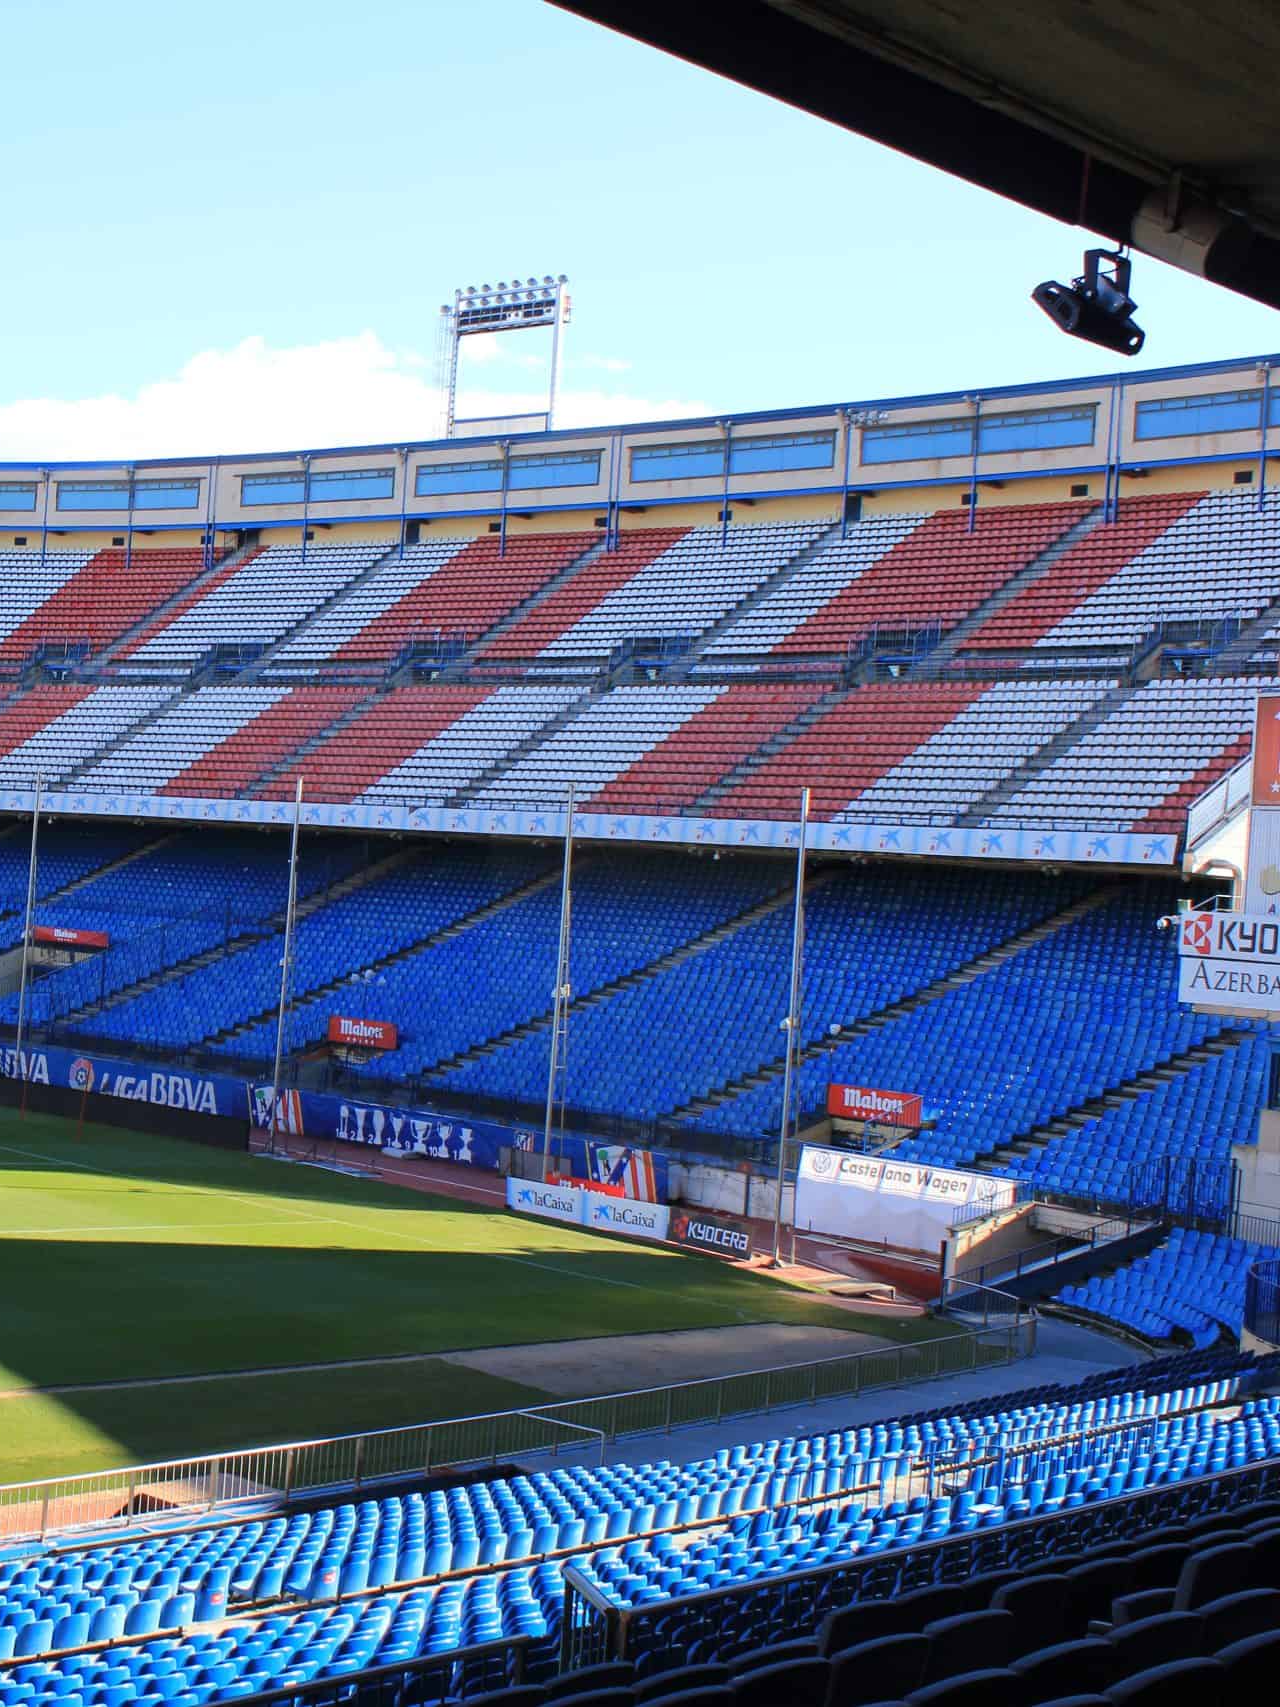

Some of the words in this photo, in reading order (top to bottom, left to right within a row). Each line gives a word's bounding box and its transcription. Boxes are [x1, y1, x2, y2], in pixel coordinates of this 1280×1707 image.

[340, 1019, 384, 1038] Mahou
[838, 1158, 912, 1183] Castellana
[917, 1168, 968, 1193] Wagen
[688, 1222, 749, 1251] KYOCERA
